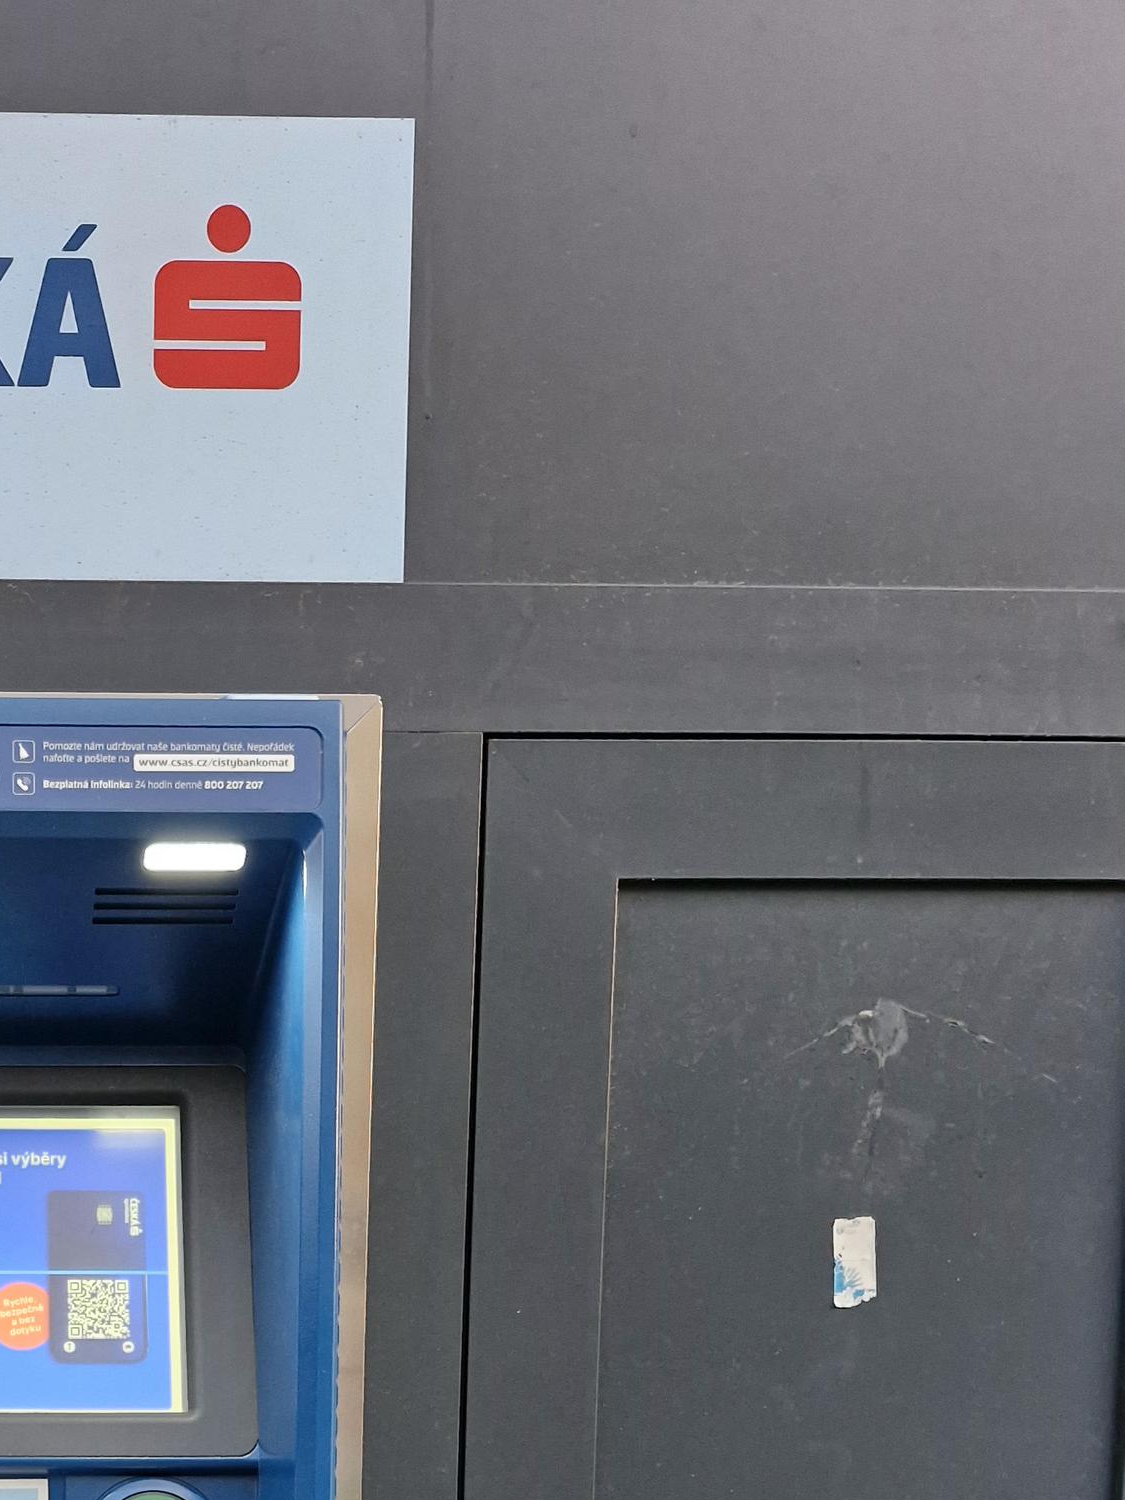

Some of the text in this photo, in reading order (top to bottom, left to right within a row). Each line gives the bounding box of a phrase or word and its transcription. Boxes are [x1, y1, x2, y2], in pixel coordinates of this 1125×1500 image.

[42, 742, 83, 752] Pomozte
[83, 742, 105, 751] nám
[106, 741, 146, 752] udržovat
[146, 742, 169, 752] naše
[170, 743, 221, 754] bankomaty
[246, 743, 295, 752] Nepořádek
[76, 755, 83, 763] a
[84, 754, 117, 765] pošlete
[117, 755, 130, 764] na
[138, 757, 290, 769] www.csas.cz/cistybankomat
[42, 779, 264, 790] Bezplatná infolinka: 24 hodin denně 800 207 207
[11, 1152, 67, 1169] výběry
[0, 1303, 44, 1319] bezpečně
[19, 1316, 36, 1325] bez
[10, 1325, 42, 1336] dotyku
